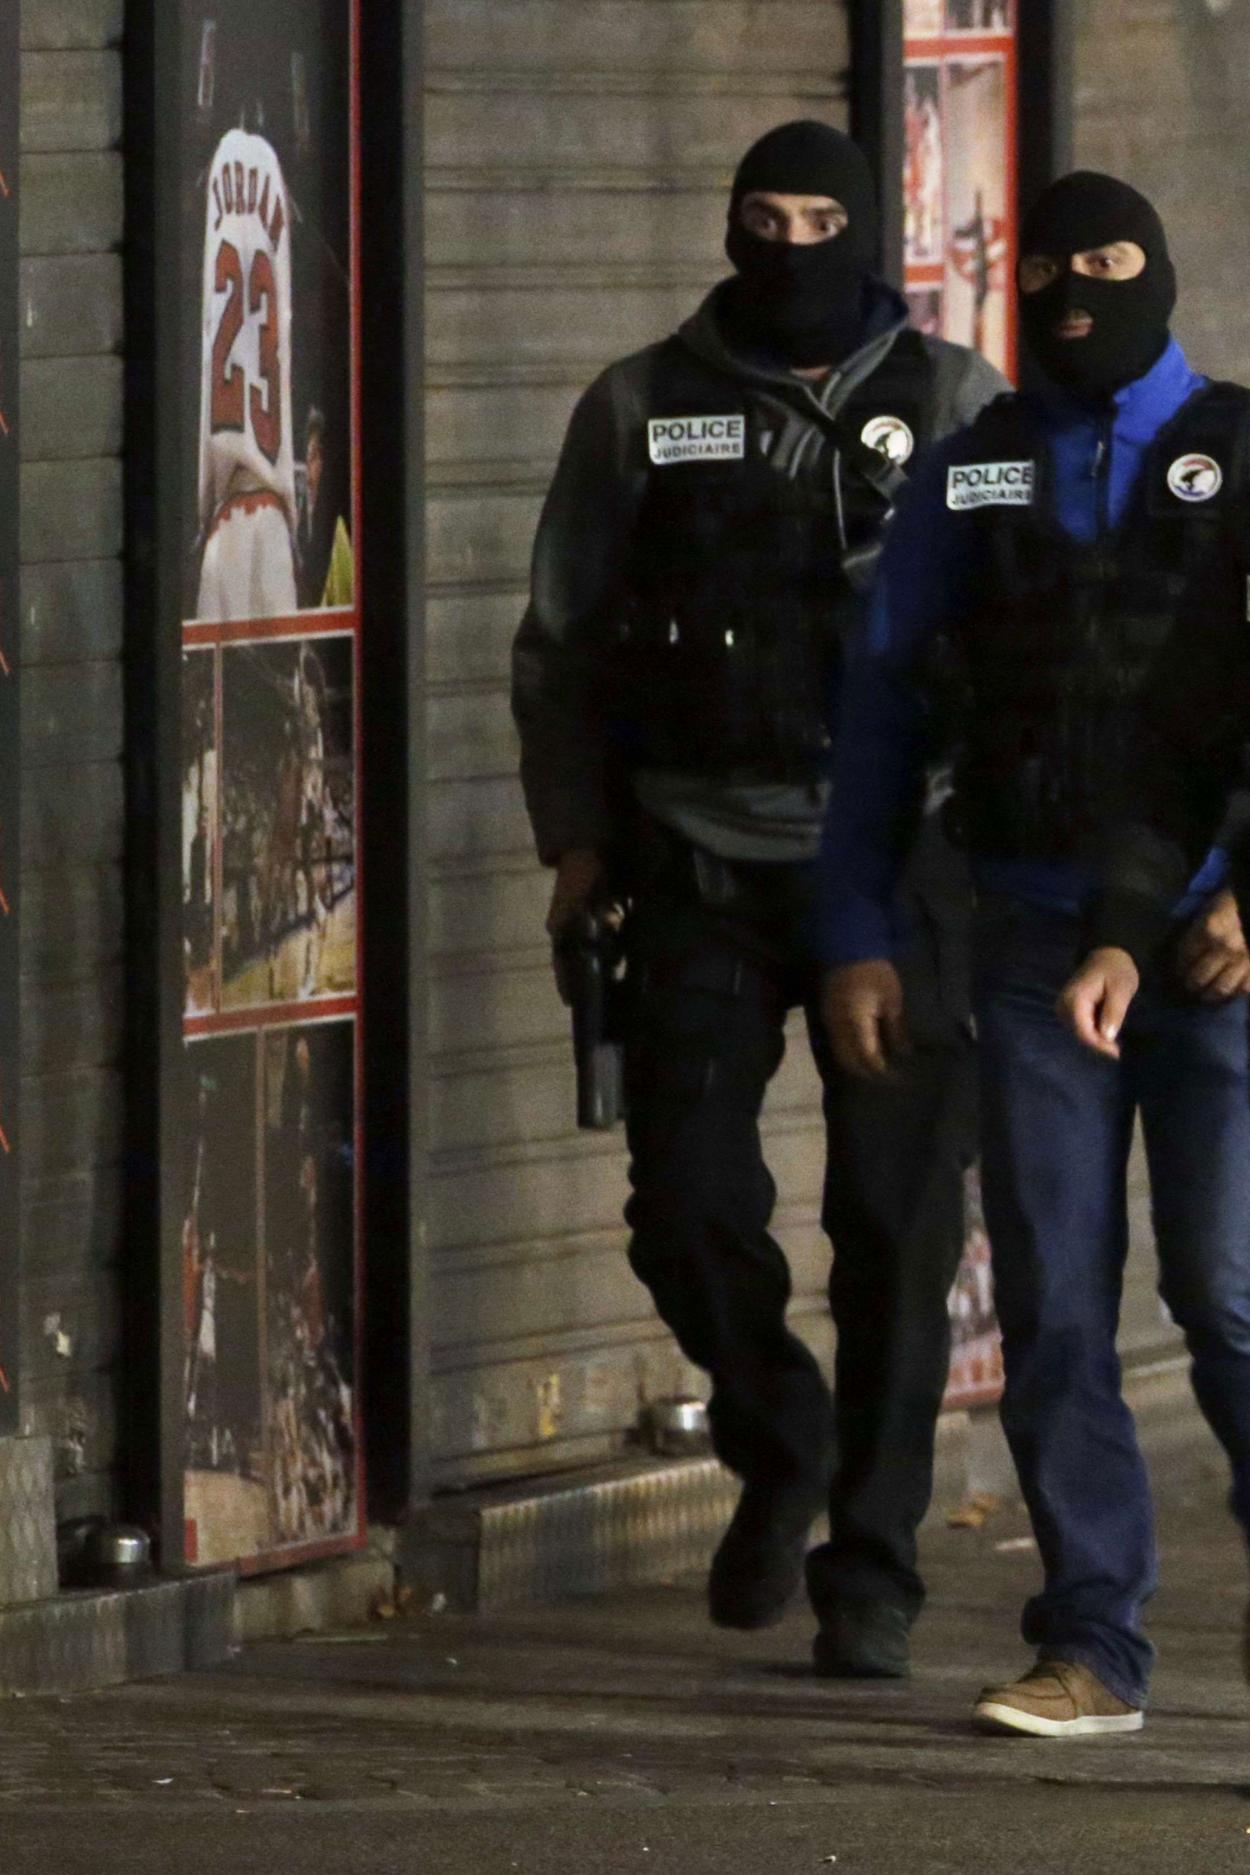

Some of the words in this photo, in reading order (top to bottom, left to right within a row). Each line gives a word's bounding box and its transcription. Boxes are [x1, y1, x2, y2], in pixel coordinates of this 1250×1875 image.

[212, 160, 284, 252] JORDAN
[210, 238, 281, 466] 23
[653, 420, 741, 442] POLICE
[654, 442, 741, 459] JUDICIAIRE
[952, 466, 1034, 489] POLICE
